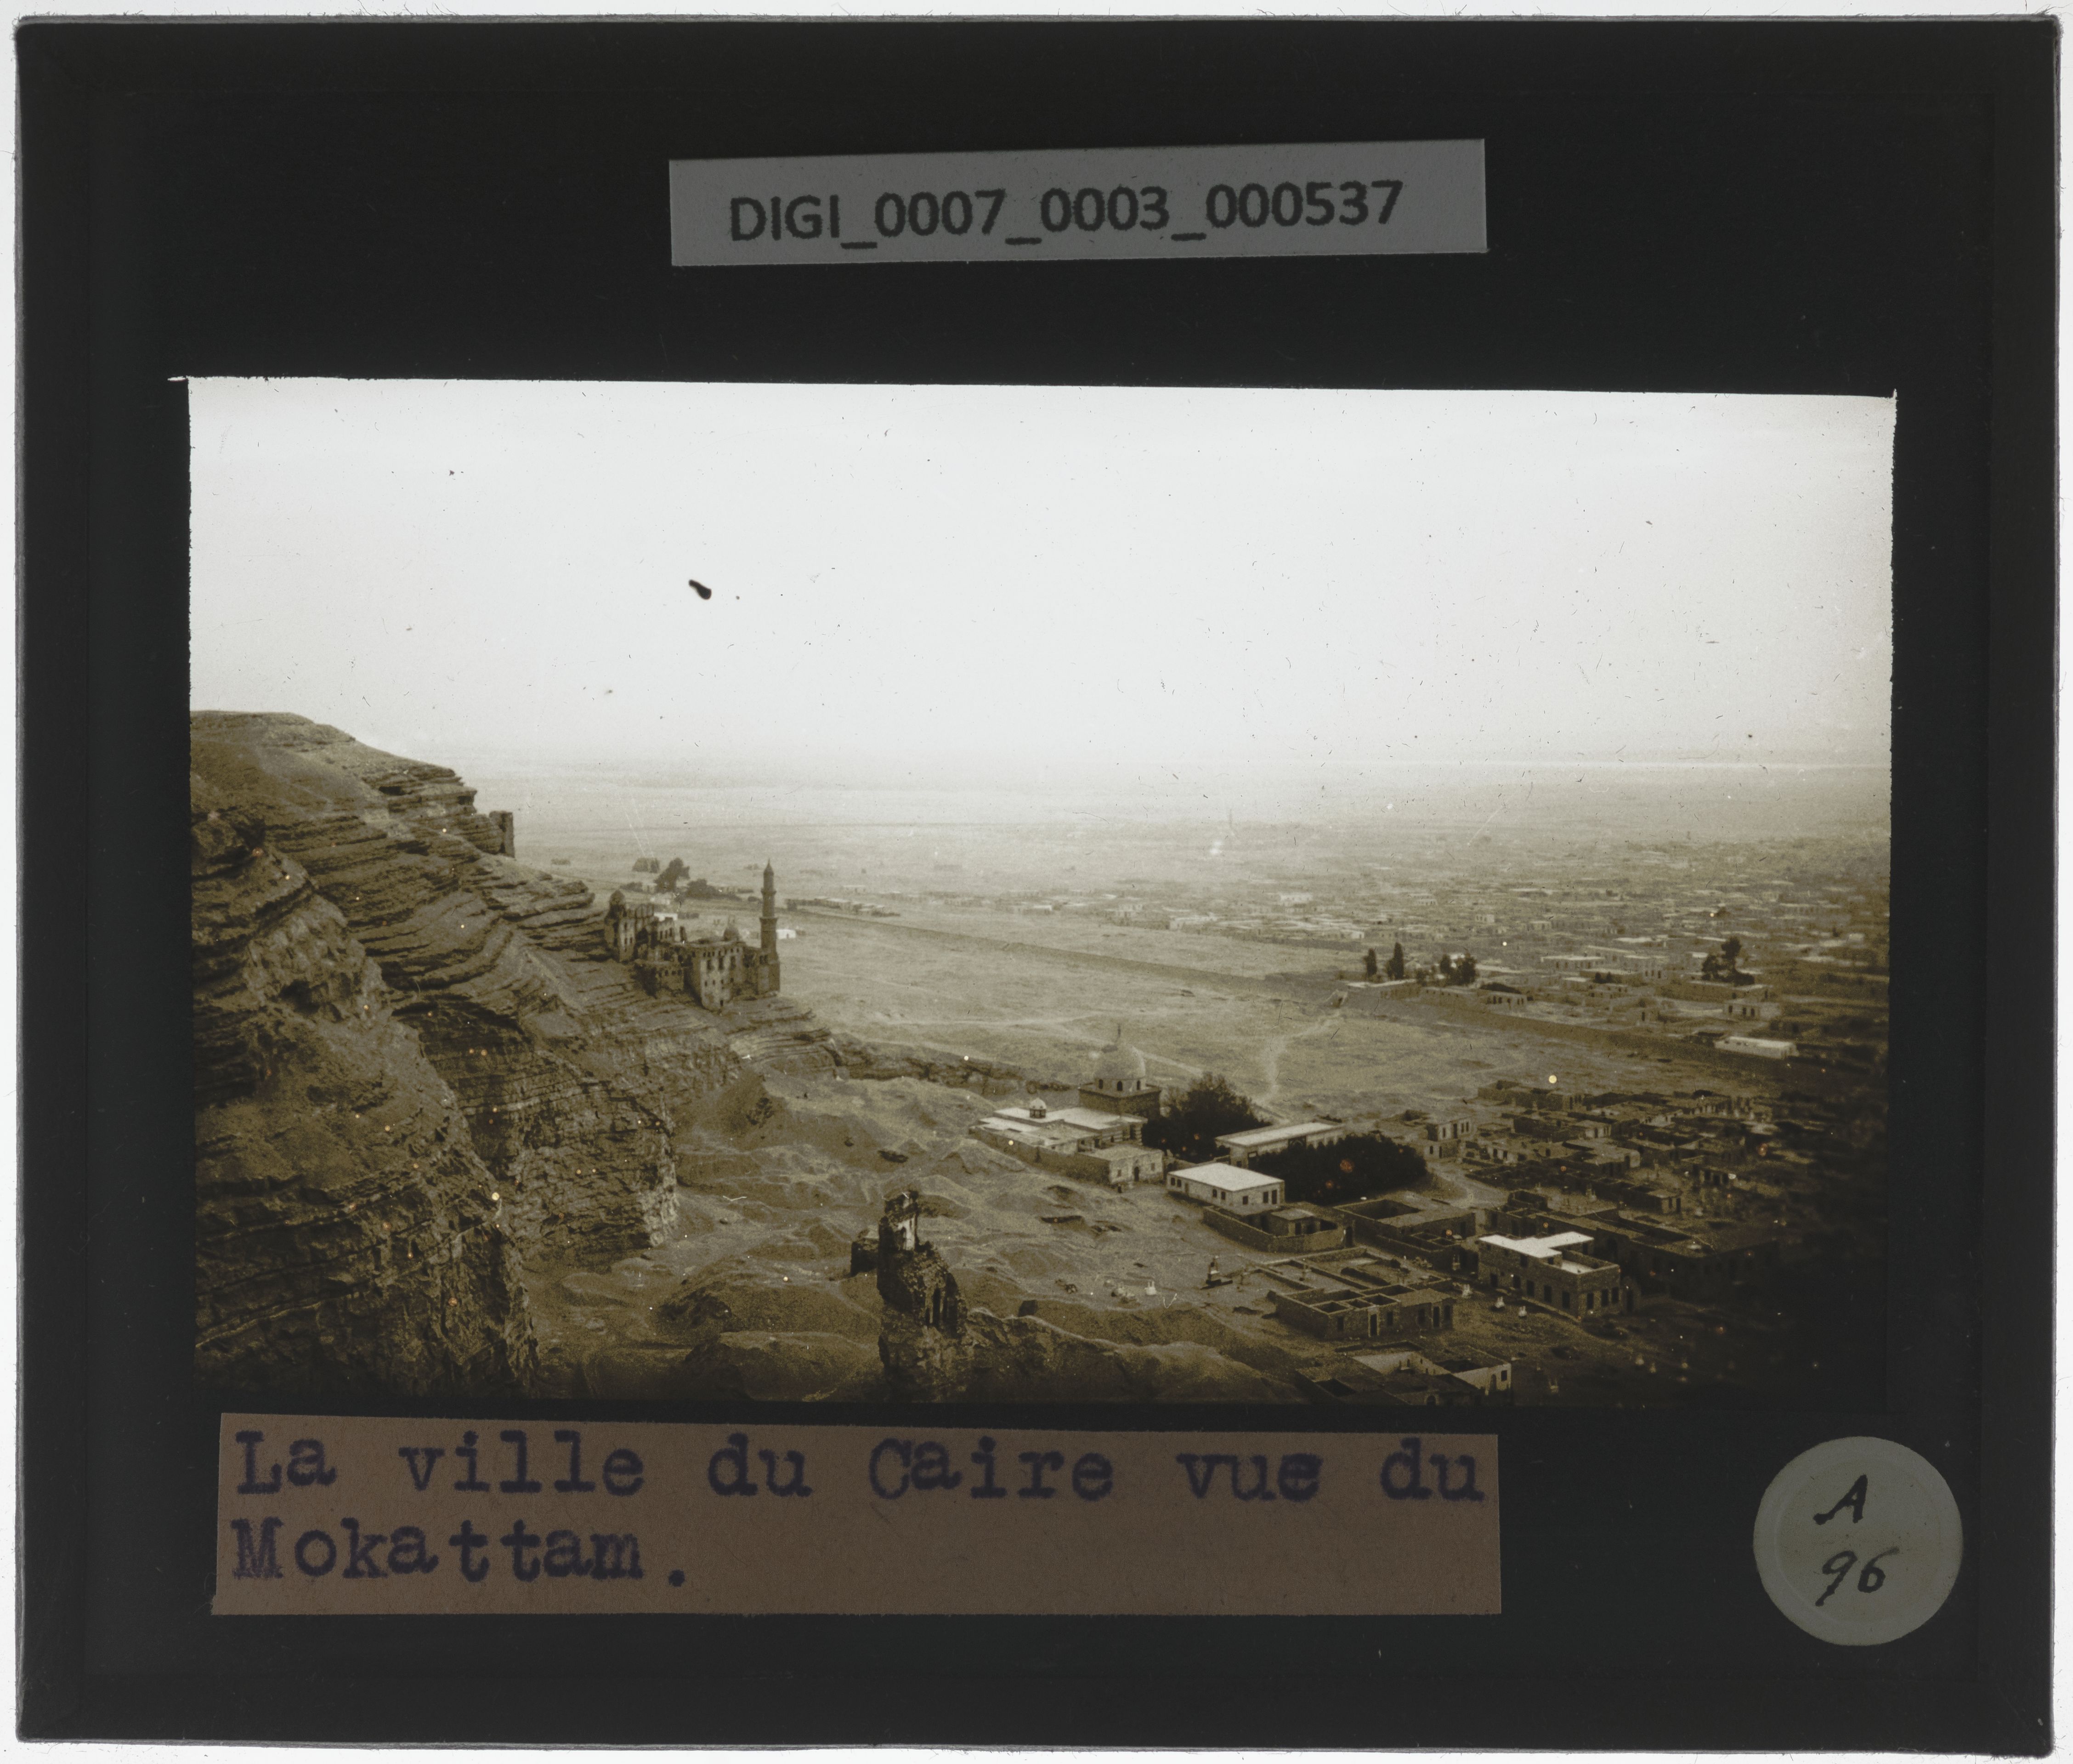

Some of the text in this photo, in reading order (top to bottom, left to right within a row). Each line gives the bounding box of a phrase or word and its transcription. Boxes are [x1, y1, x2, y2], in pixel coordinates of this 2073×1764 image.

[730, 180, 1405, 250] DIGI_0007_0003_000537
[236, 1429, 1487, 1502] La ville du Caire vue du
[1813, 1474, 1868, 1525] A
[232, 1517, 685, 1588] Mokattam.
[1815, 1547, 1900, 1606] 96
